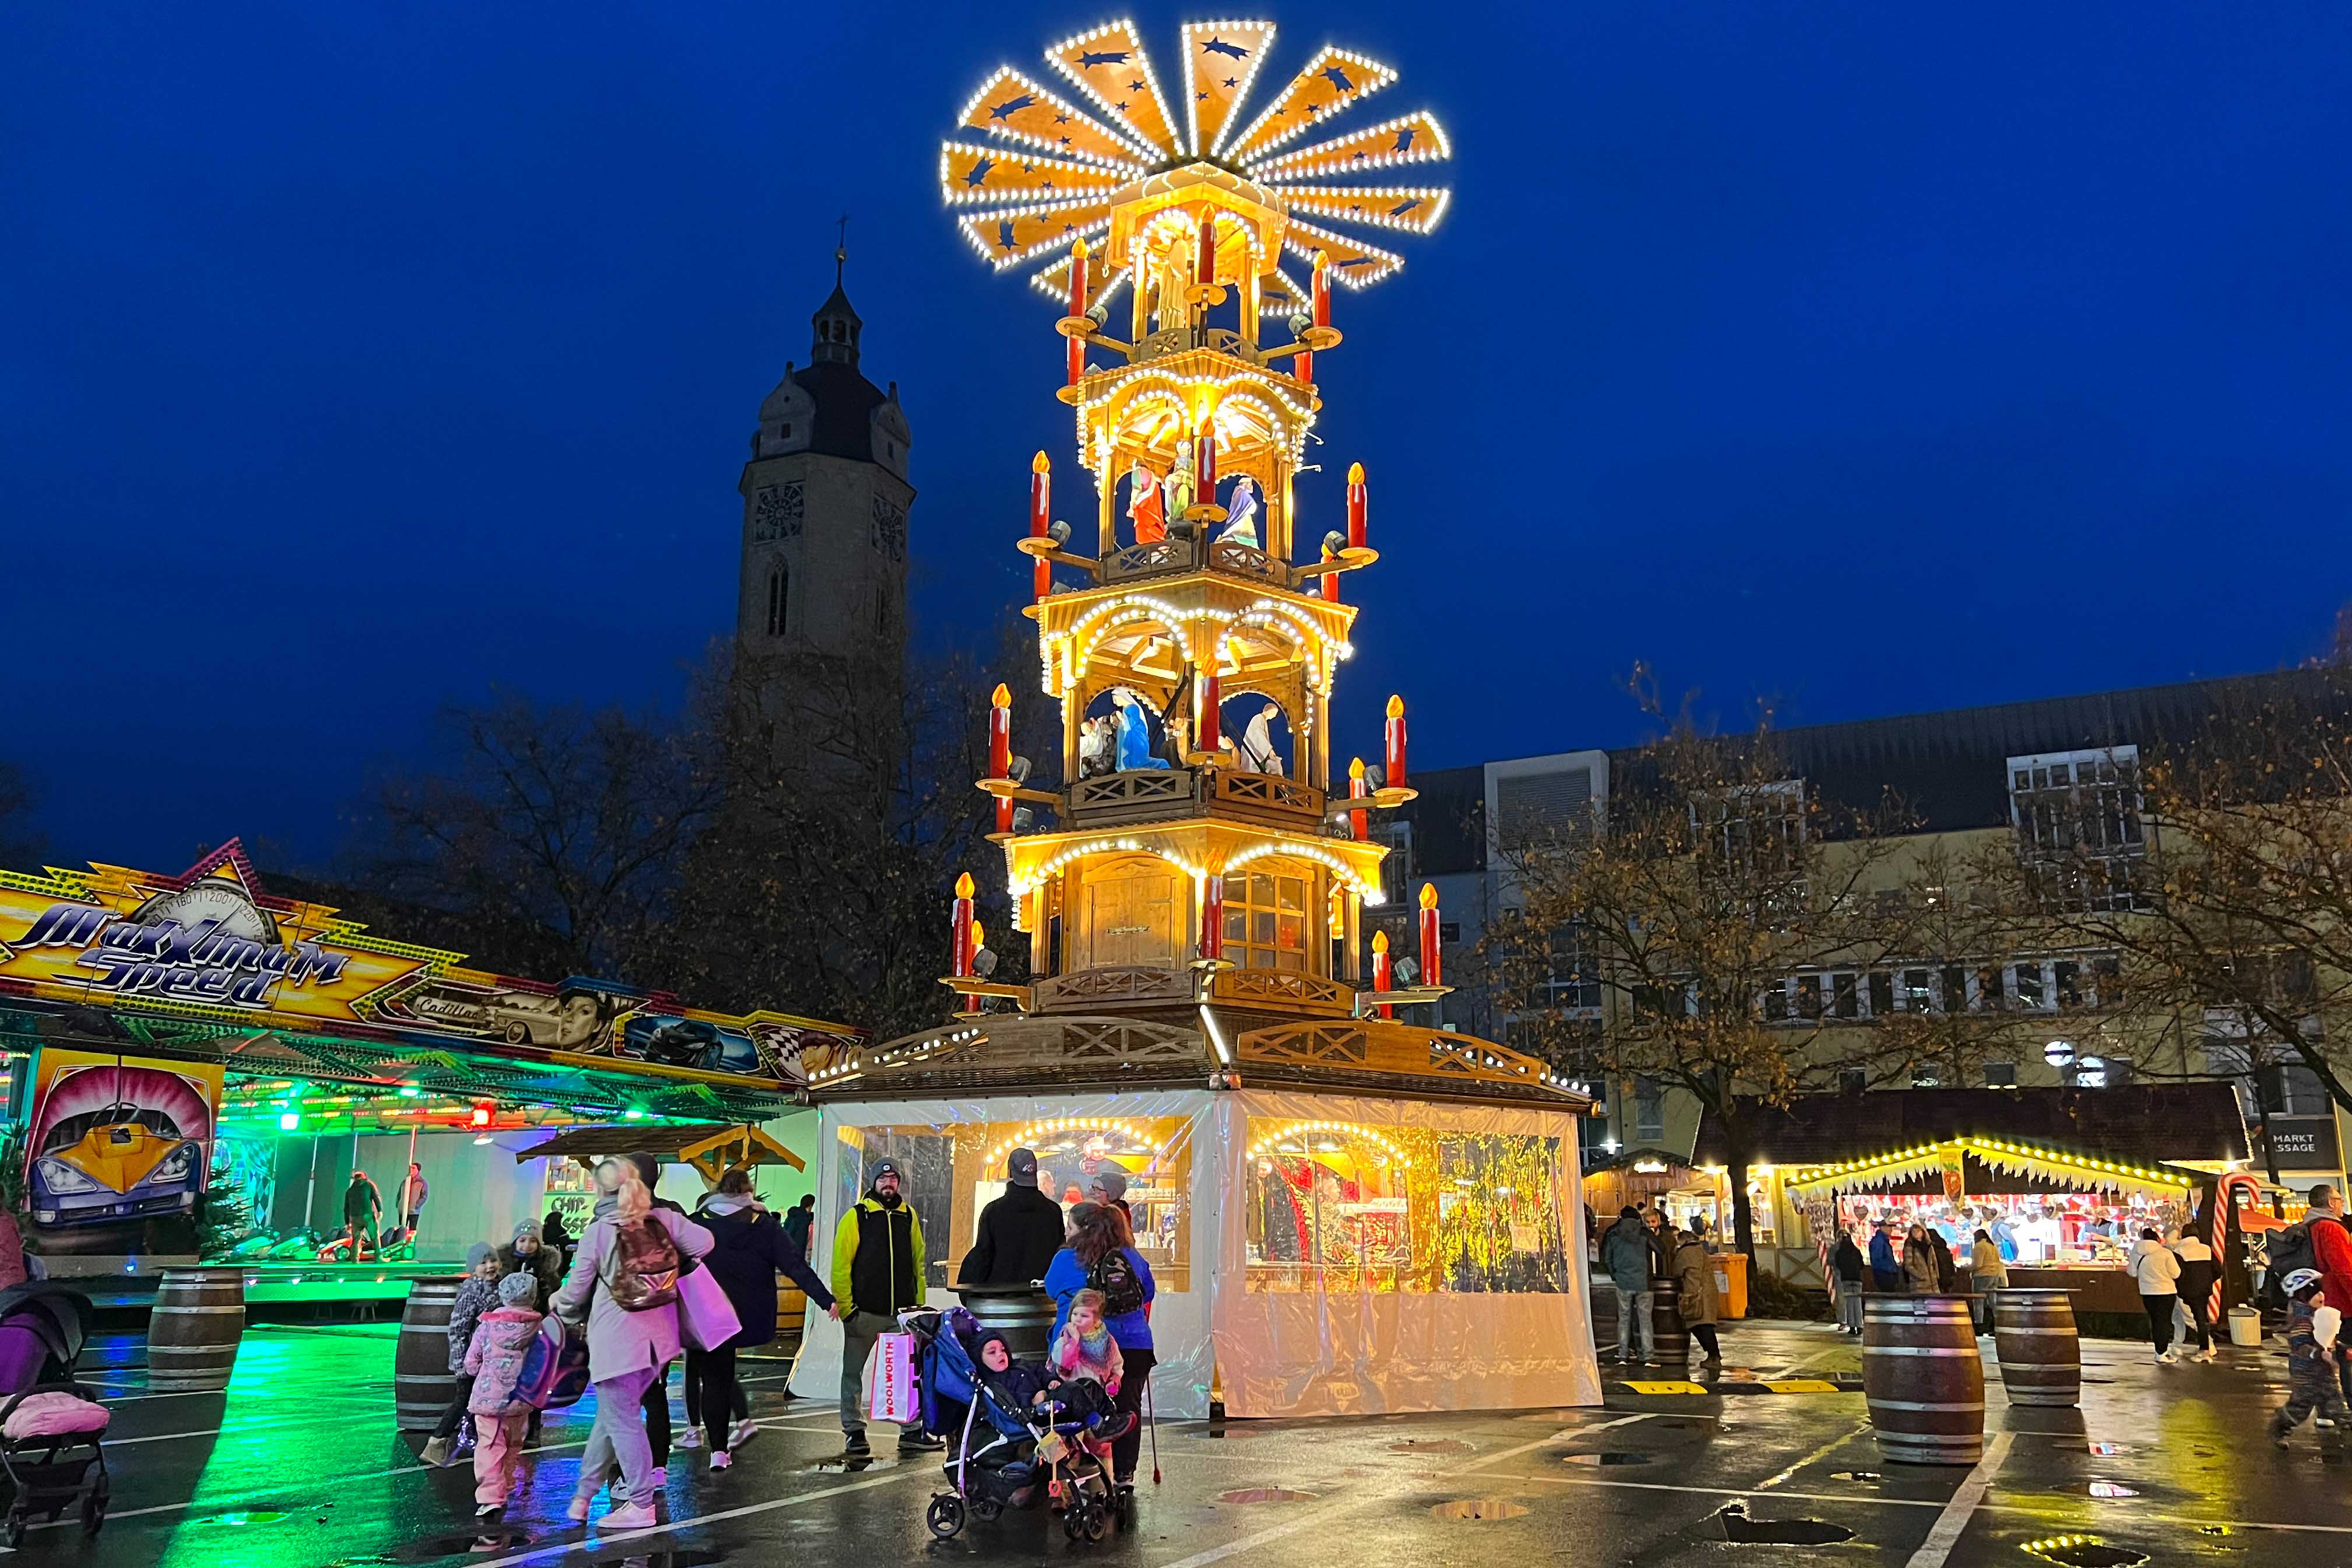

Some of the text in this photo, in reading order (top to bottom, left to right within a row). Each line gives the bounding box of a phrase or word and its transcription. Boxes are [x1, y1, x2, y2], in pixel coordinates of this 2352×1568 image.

[177, 894, 191, 908] 180
[210, 892, 229, 904] 200
[240, 905, 254, 922] 220
[51, 948, 283, 1008] Speed
[2262, 1144, 2315, 1152] SSAGE
[2273, 1135, 2314, 1143] MARKT
[886, 1342, 894, 1416] WOOLWORTH
